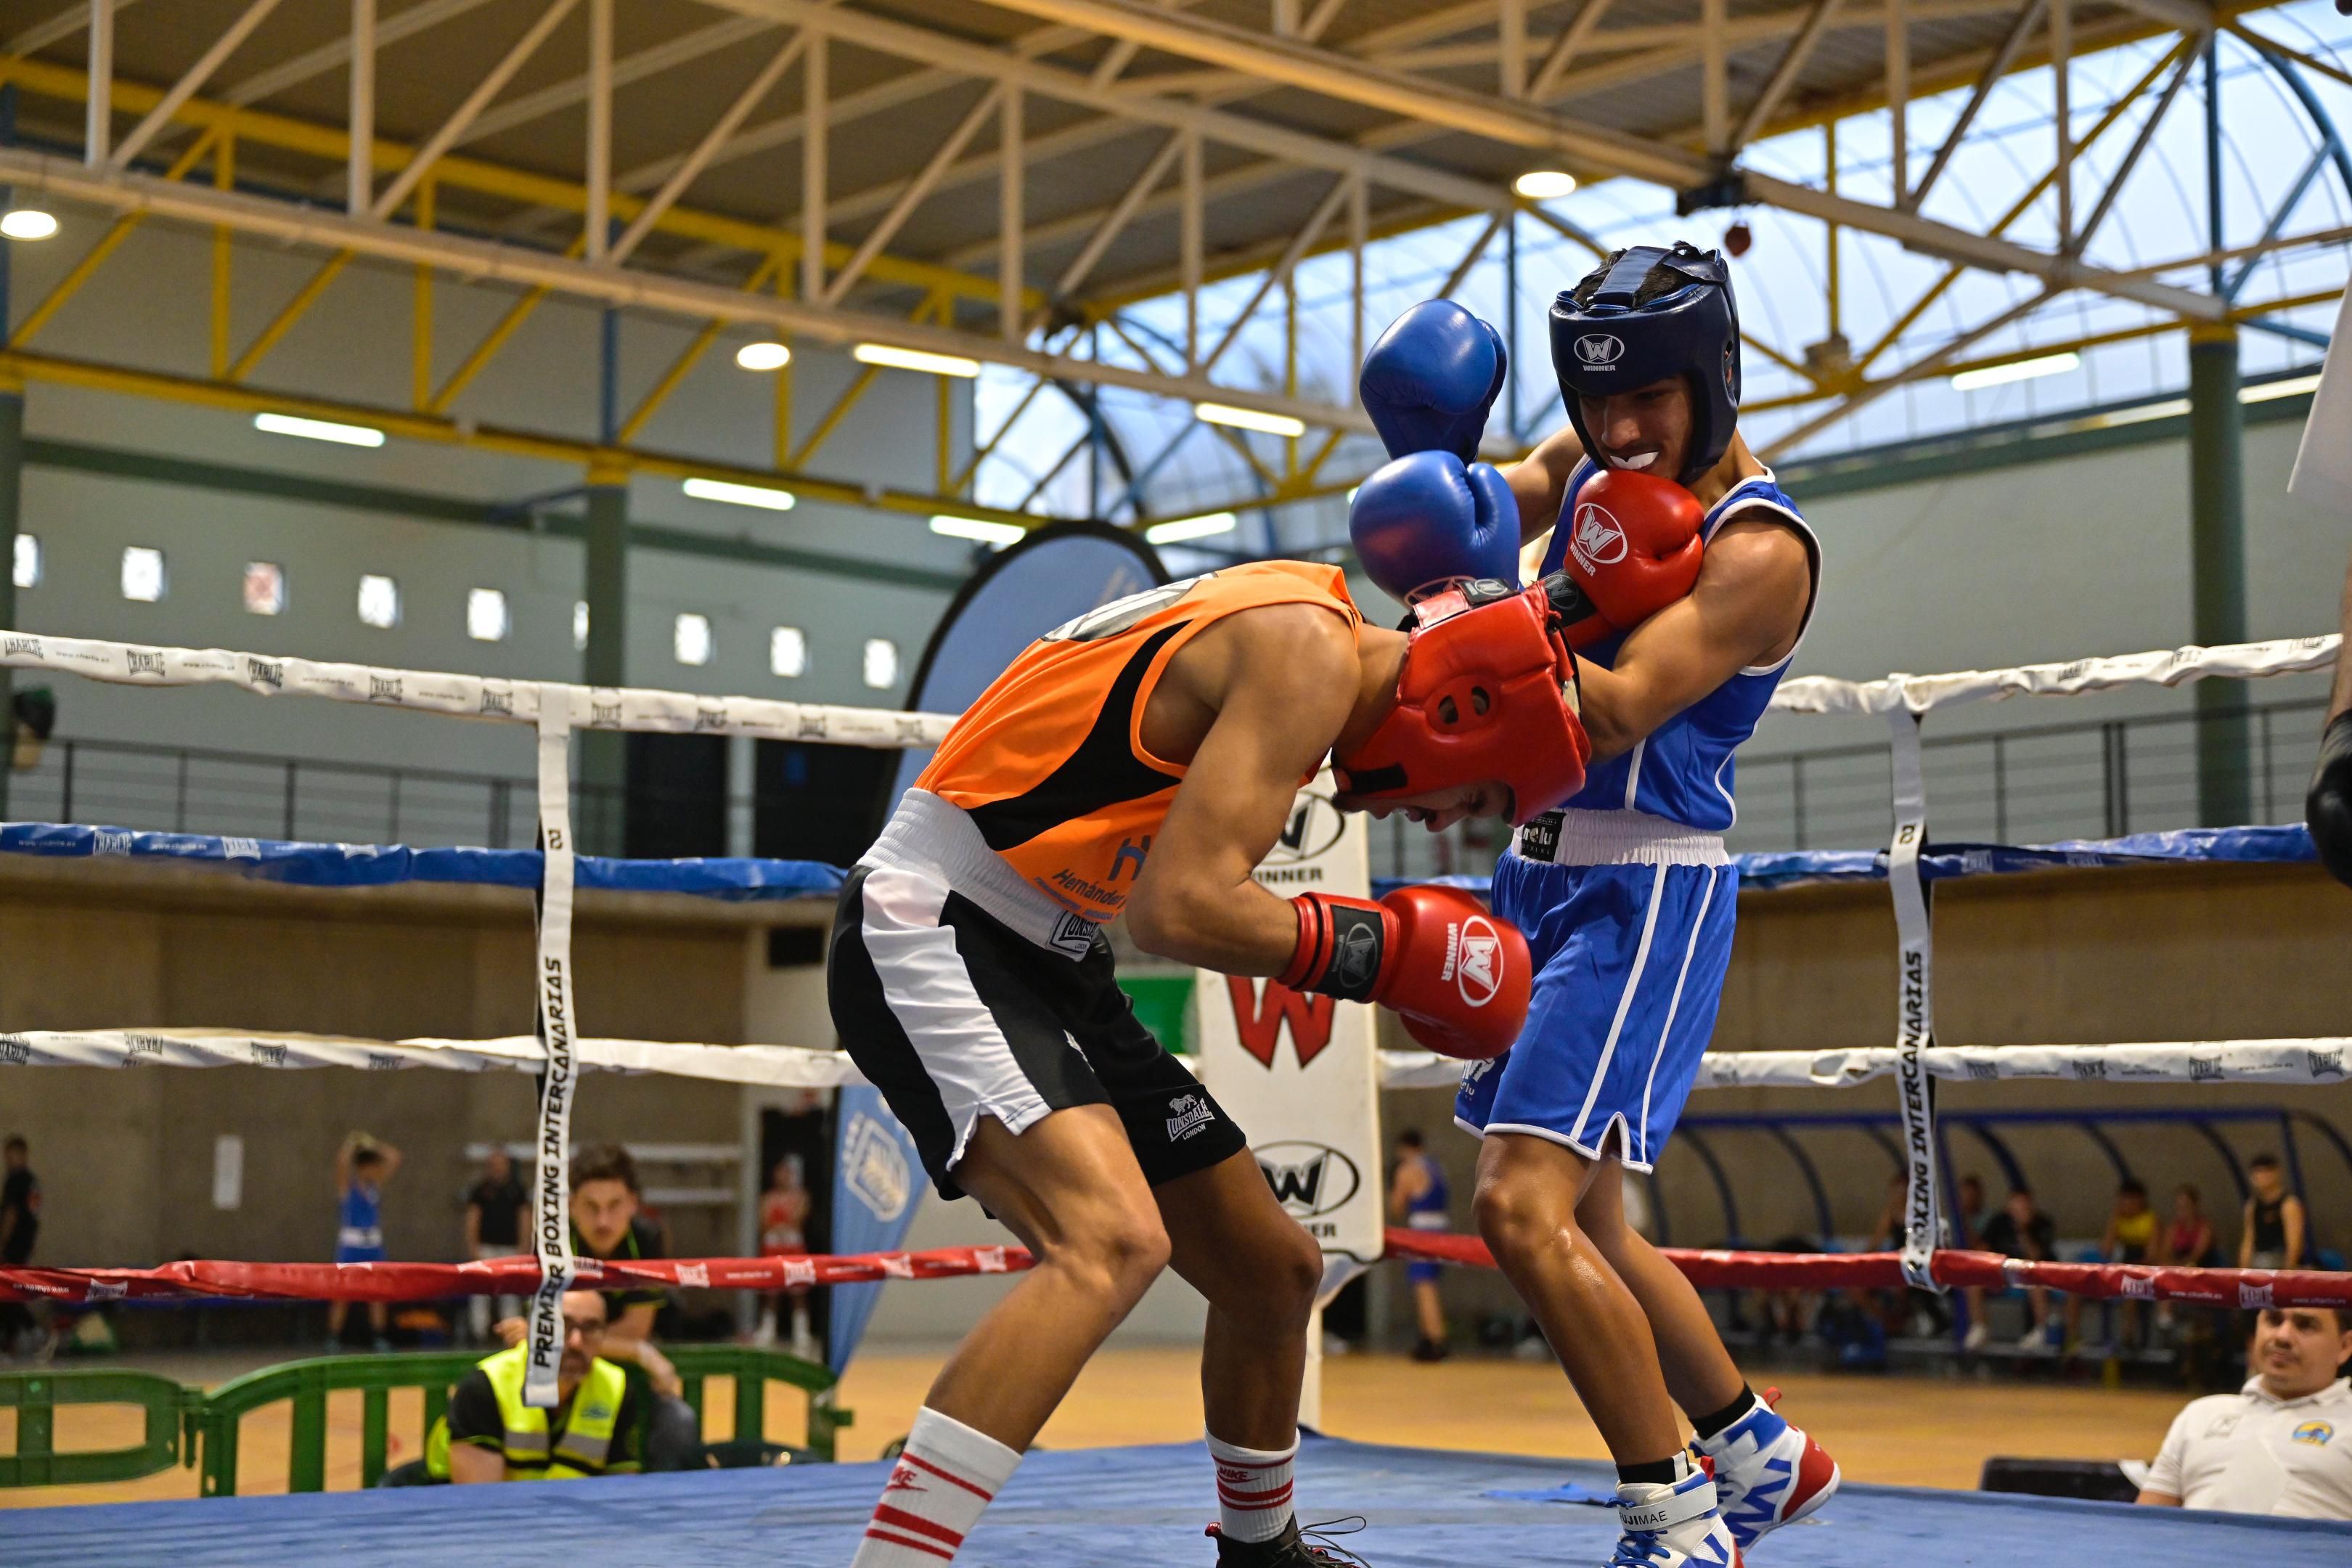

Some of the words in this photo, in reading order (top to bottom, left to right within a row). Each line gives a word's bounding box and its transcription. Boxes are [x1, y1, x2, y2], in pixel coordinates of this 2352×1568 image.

[1569, 540, 1596, 577] WINNER
[1251, 867, 1323, 882] INNER
[1441, 923, 1458, 981] WINNER
[544, 956, 570, 1158] INTERCANARIAS
[1902, 951, 1927, 1156] INTERCANARIAS
[1166, 1097, 1215, 1143] LONSDALE
[1182, 1122, 1206, 1140] LONDON
[543, 1166, 563, 1257] BOXING
[1913, 1162, 1930, 1256] OXING
[534, 1264, 565, 1368] PREMIER
[1219, 1466, 1248, 1482] NIKE
